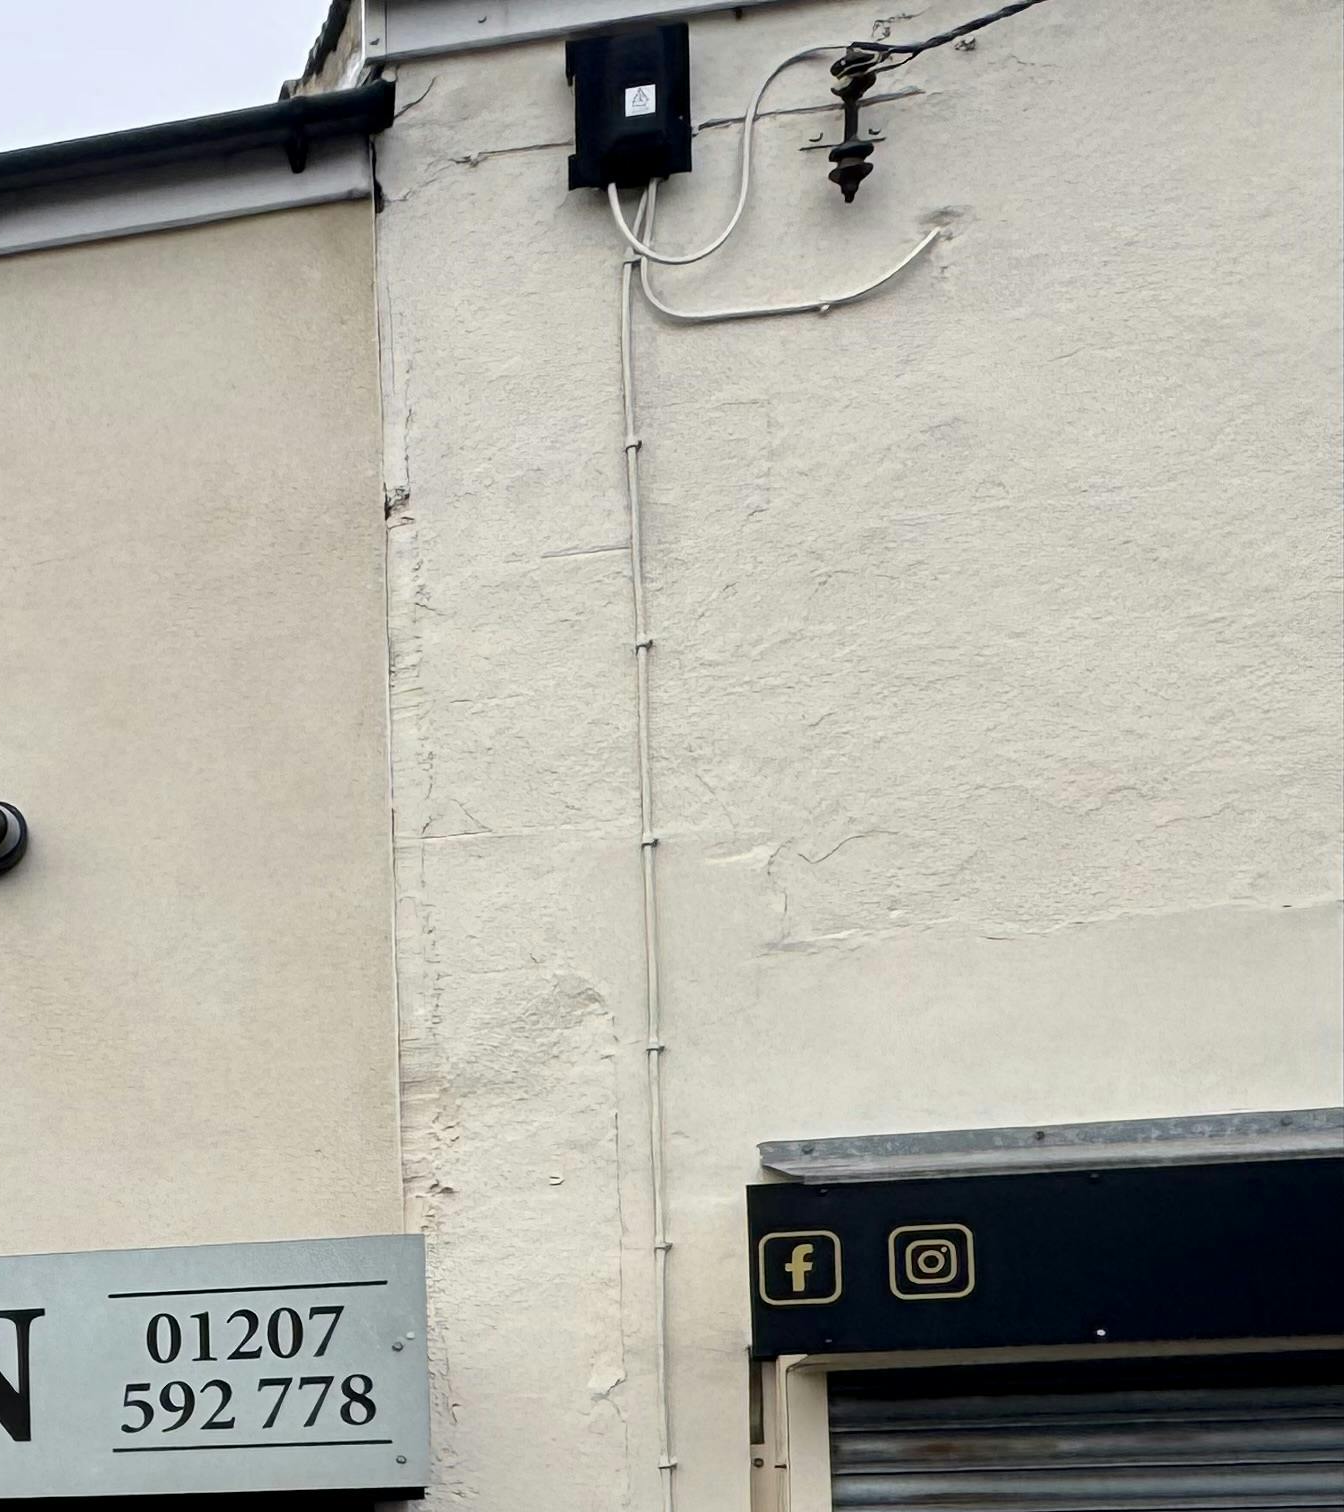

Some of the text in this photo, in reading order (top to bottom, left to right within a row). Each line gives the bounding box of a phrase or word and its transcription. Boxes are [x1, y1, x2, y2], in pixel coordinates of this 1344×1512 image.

[146, 1304, 345, 1364] 01207
[120, 1373, 377, 1434] 592 778
